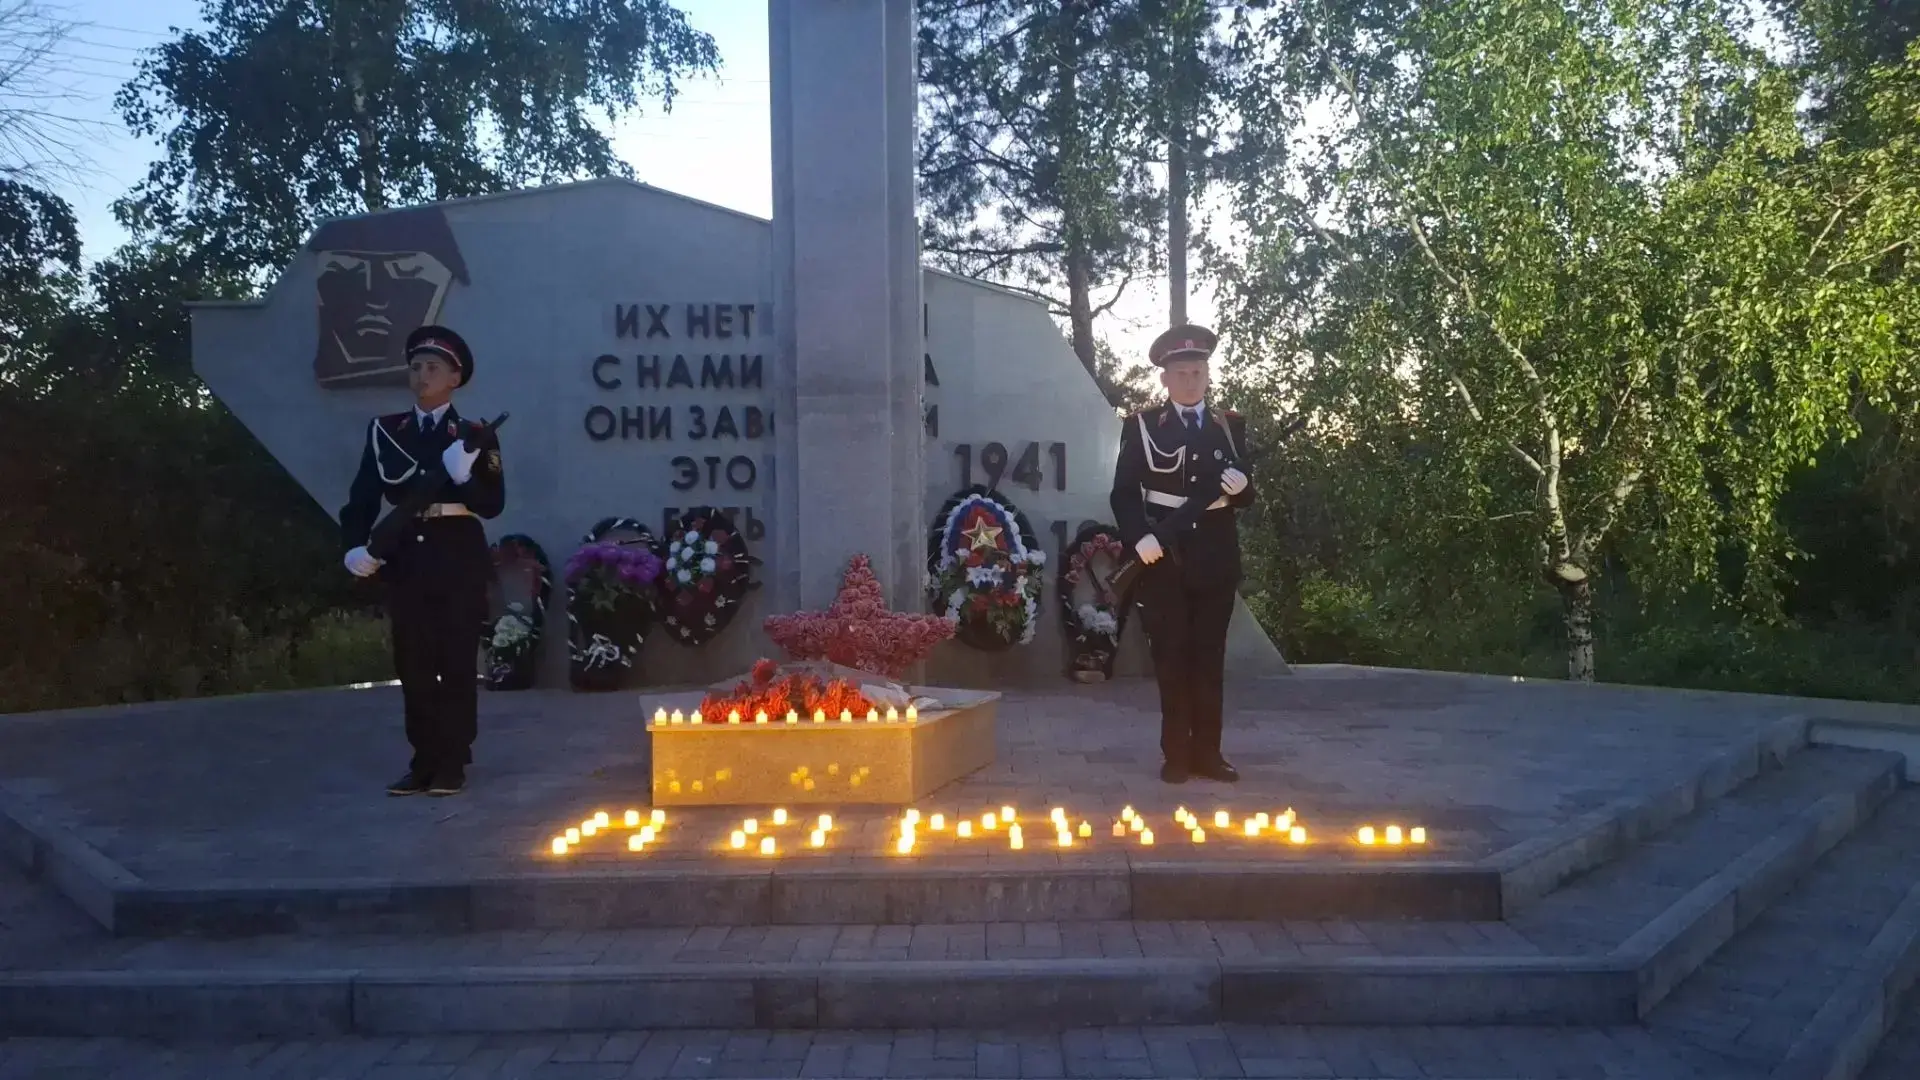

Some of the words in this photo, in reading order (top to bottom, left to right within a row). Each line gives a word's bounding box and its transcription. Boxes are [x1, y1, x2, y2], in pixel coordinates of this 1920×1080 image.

[615, 303, 670, 339] ИХ
[686, 303, 755, 339] НЕТ
[592, 354, 622, 389] С
[637, 353, 763, 389] НАМИ
[584, 405, 671, 441] ОНИ
[671, 455, 757, 490] ЭТО
[954, 441, 1067, 492] 1941
